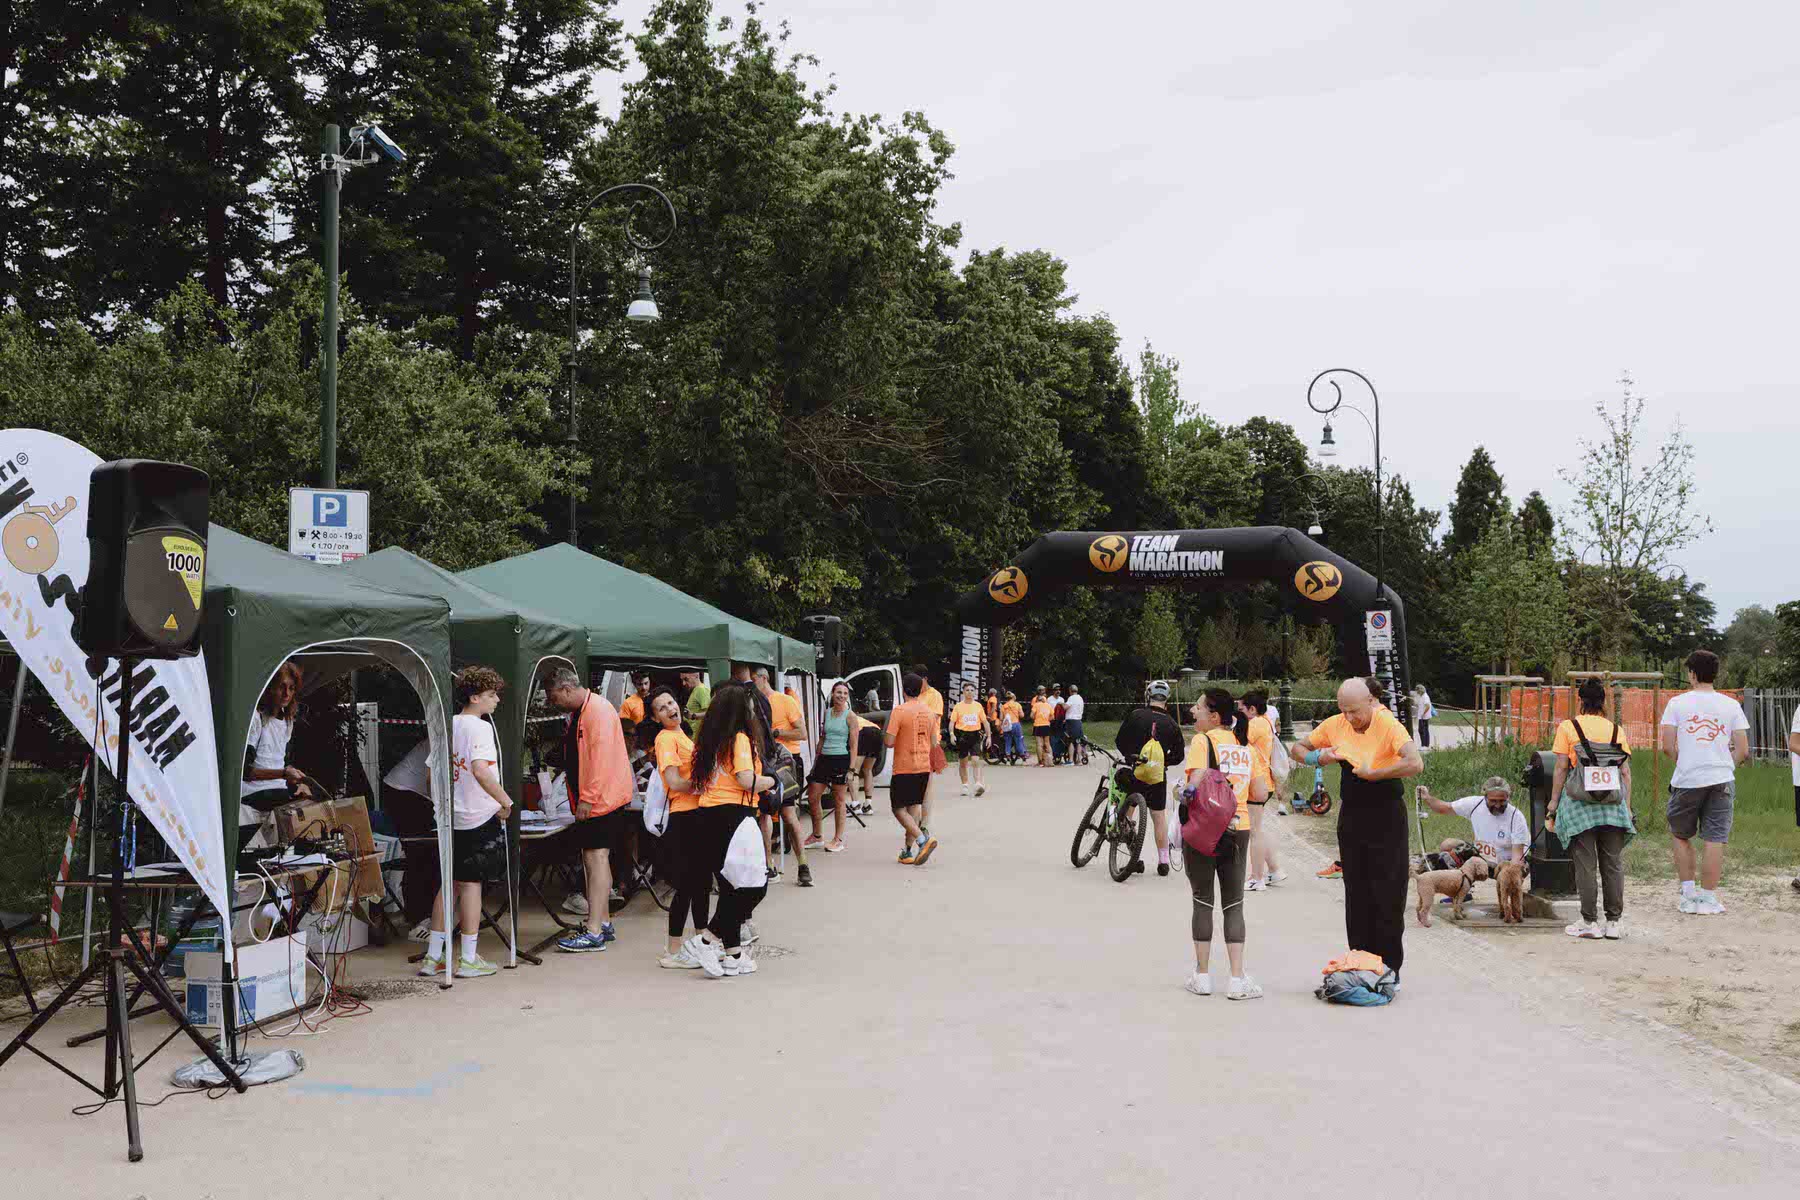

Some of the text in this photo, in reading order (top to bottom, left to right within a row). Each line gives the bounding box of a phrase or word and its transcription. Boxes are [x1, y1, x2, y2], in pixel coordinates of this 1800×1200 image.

[319, 496, 341, 523] P
[1131, 534, 1181, 552] TEAM
[168, 552, 201, 573] 1000
[1129, 550, 1224, 572] MARATHON
[1221, 750, 1250, 768] 294
[1591, 771, 1612, 784] 80
[1475, 841, 1497, 858] 205
